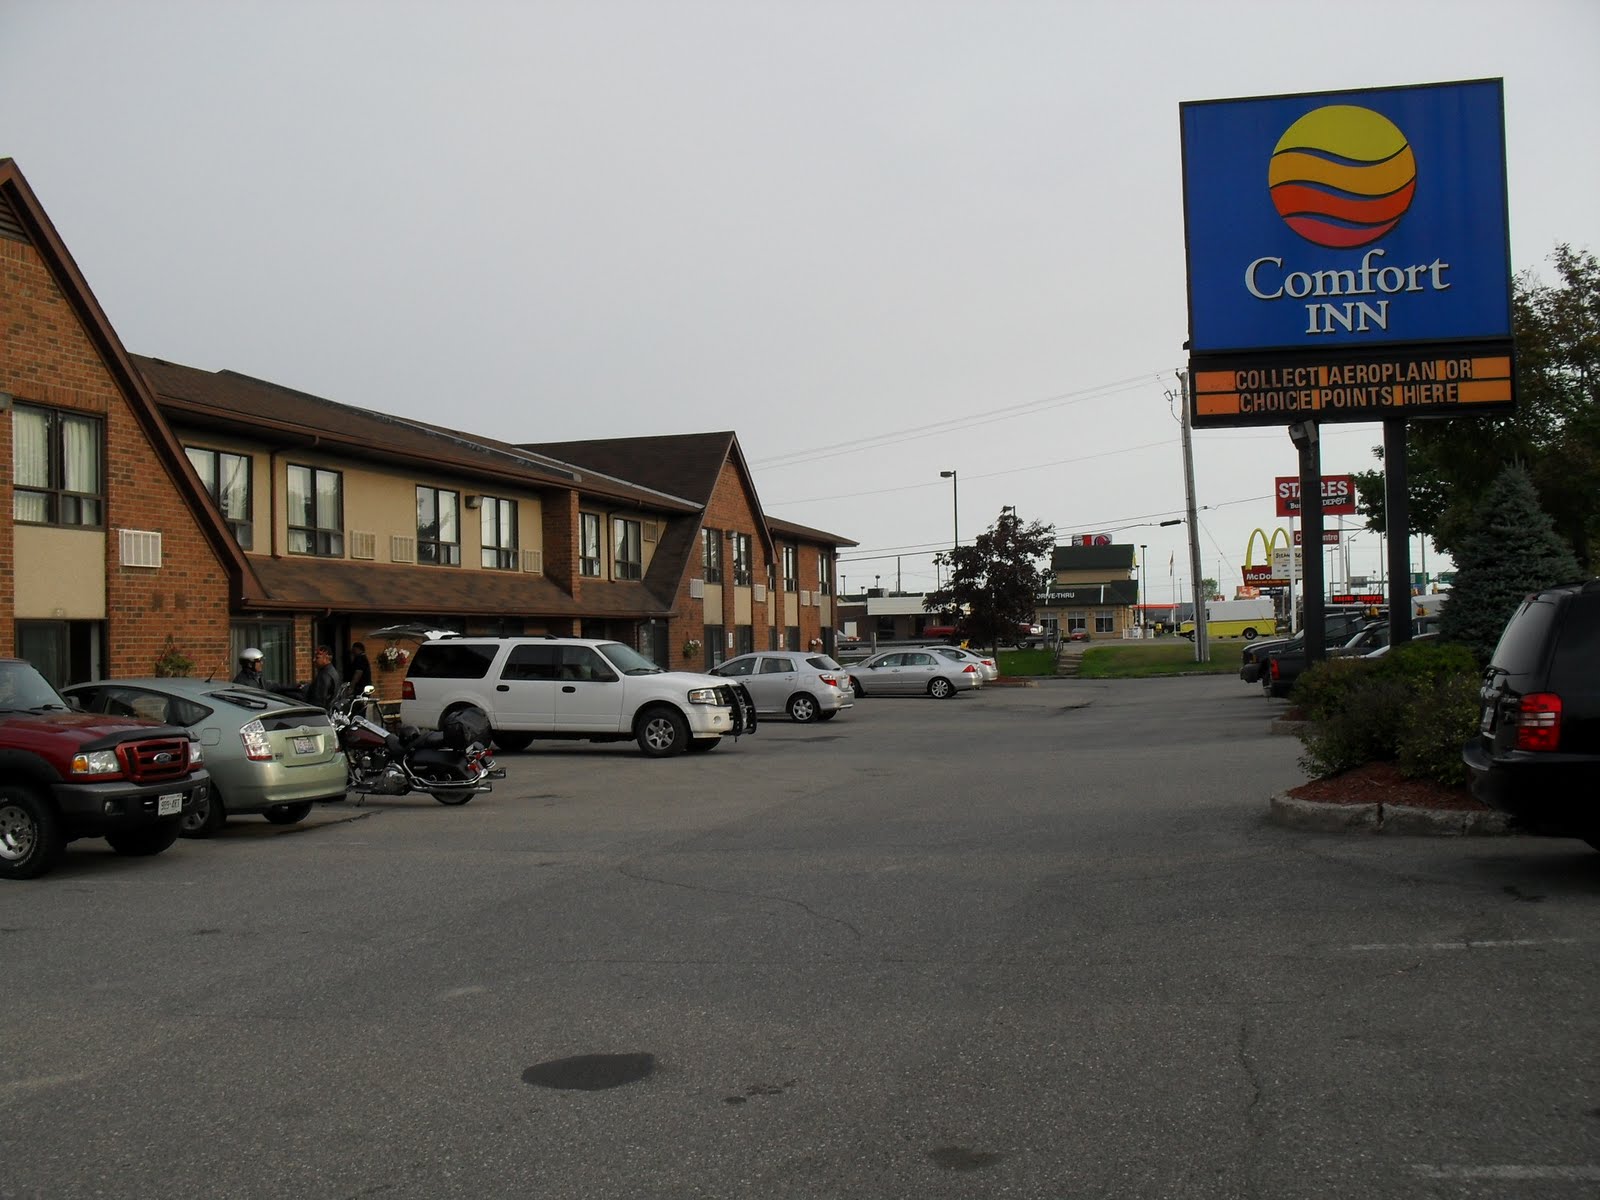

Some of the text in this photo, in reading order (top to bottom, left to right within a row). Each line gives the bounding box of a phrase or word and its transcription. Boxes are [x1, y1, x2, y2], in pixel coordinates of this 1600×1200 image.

[1244, 248, 1451, 299] Comfort
[1305, 300, 1389, 334] INN
[1235, 358, 1472, 390] COLLECT AEROPLAN OR
[1239, 383, 1457, 412] CHOICE POINTS HERE
